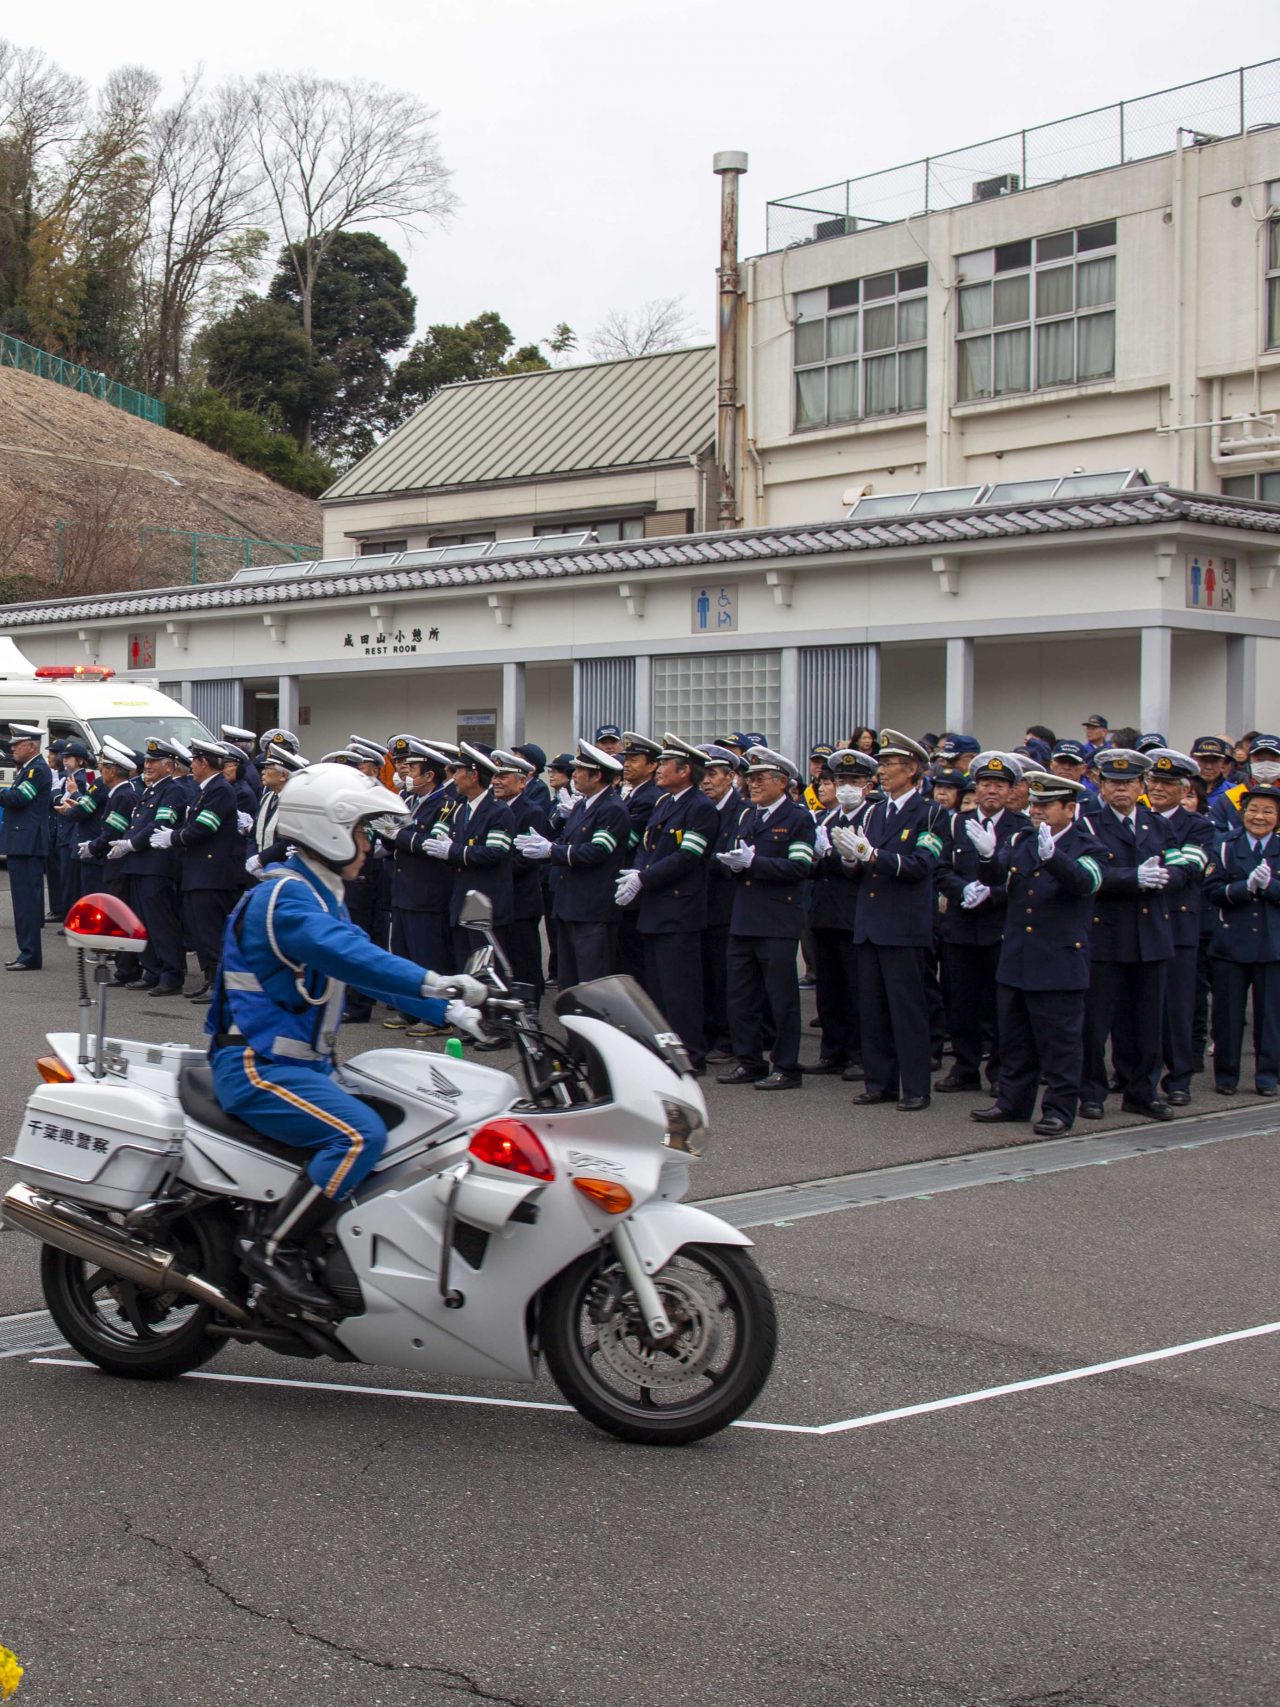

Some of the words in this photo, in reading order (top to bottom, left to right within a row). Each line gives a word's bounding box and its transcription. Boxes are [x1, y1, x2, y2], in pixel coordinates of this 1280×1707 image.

[344, 627, 440, 647] 成田山小憩所
[365, 647, 388, 655] REST
[393, 645, 417, 653] ROOM
[28, 1120, 109, 1154] 千葉県警察
